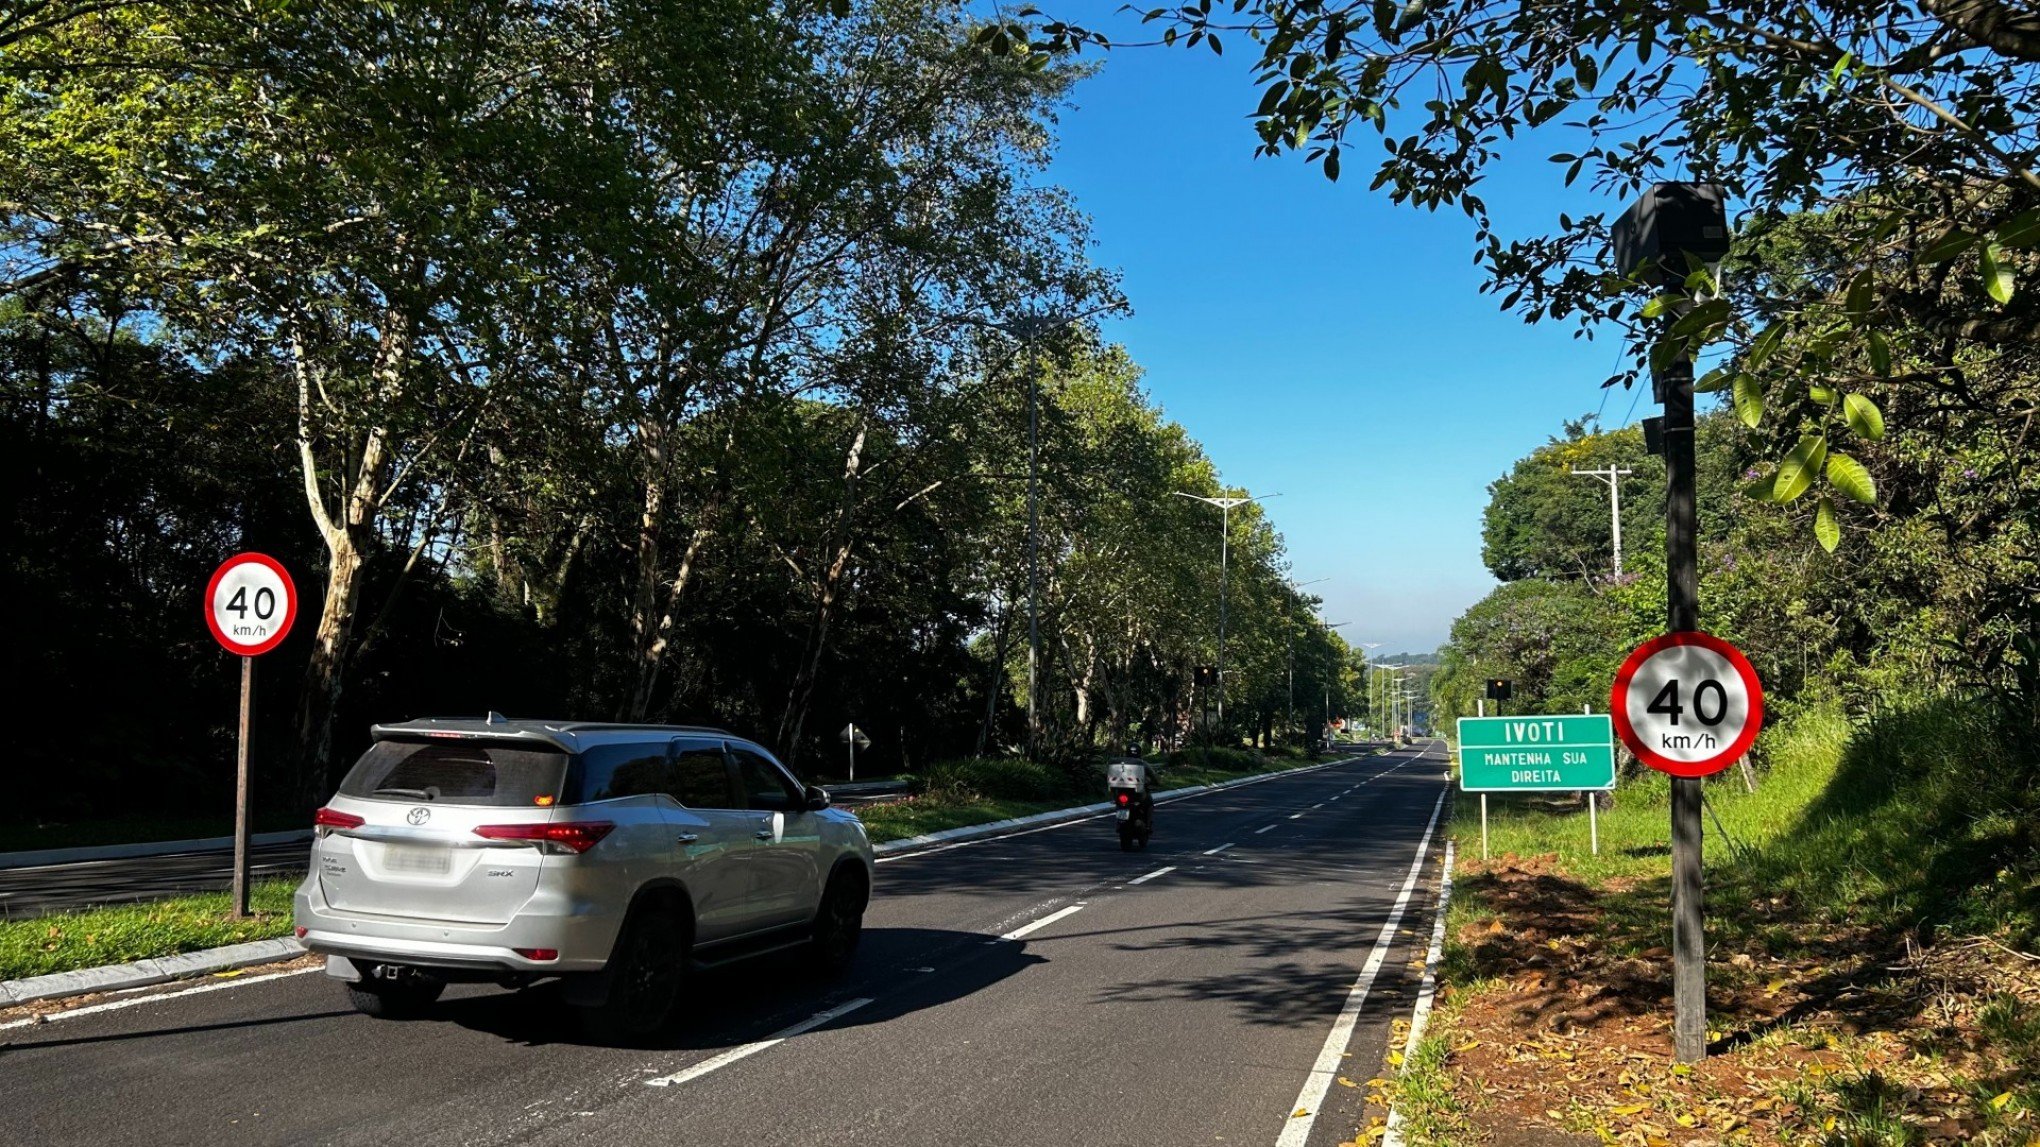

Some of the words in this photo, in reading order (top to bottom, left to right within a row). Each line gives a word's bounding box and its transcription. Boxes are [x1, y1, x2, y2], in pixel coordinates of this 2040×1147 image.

[226, 586, 275, 620] 40
[233, 625, 267, 636] km/h
[1646, 679, 1728, 727] 40
[1505, 721, 1564, 742] IVOTI
[1662, 733, 1716, 749] km/h
[1484, 753, 1551, 766] MANTENHA
[1562, 752, 1588, 765] SUA
[1511, 770, 1562, 783] DIREITA
